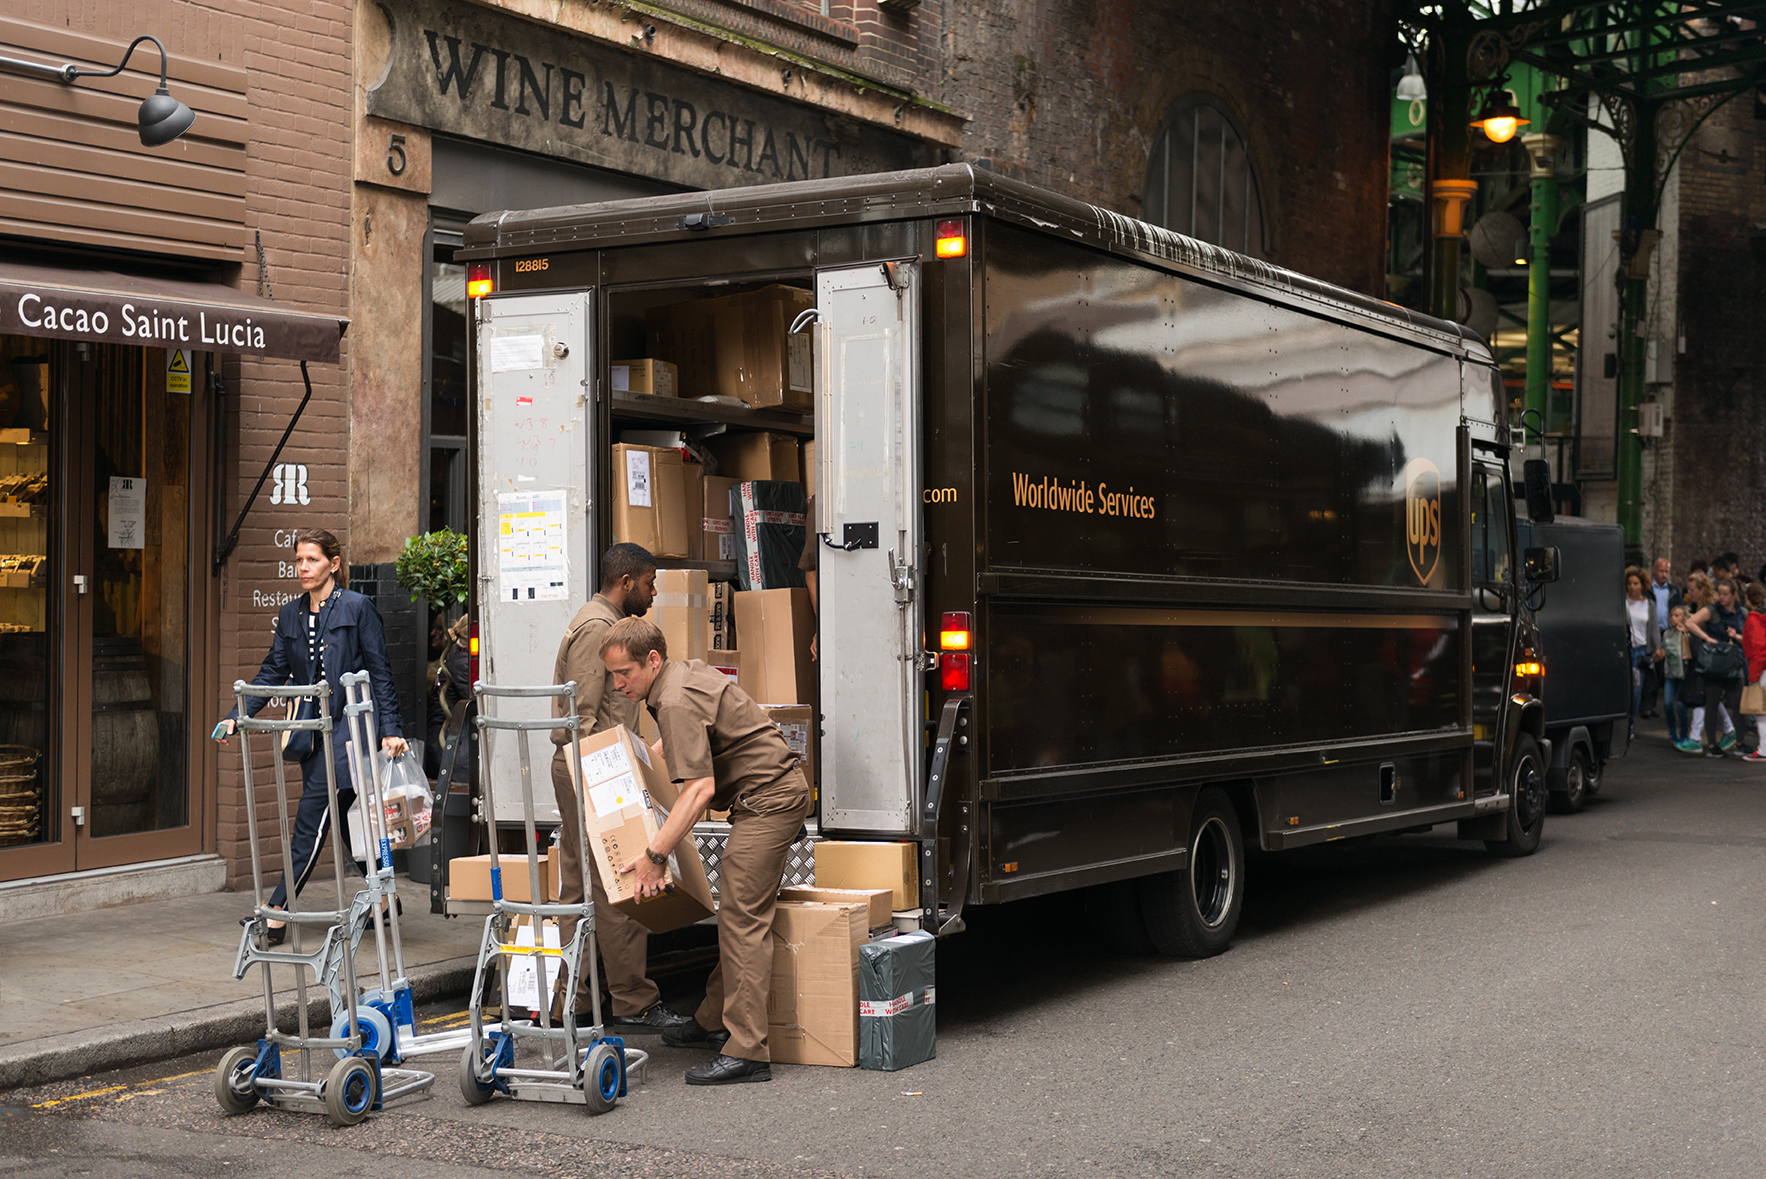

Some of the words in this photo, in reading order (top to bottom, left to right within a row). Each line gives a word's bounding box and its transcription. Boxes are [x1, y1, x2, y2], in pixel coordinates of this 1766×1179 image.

[423, 29, 586, 129] WINE
[601, 80, 841, 180] MERCHANT
[388, 133, 406, 175] 5
[515, 258, 549, 273] 128815
[17, 293, 109, 334] Cacao
[121, 303, 189, 341] Saint
[200, 311, 266, 349] Lucia
[923, 487, 957, 503] com
[1012, 472, 1094, 514] Worldwide
[1098, 482, 1155, 519] Services
[274, 529, 297, 549] Caf
[1409, 497, 1438, 565] ups
[381, 839, 390, 868] EXPRESSO
[889, 996, 906, 1008] HANDLE
[899, 1002, 909, 1011] CARE
